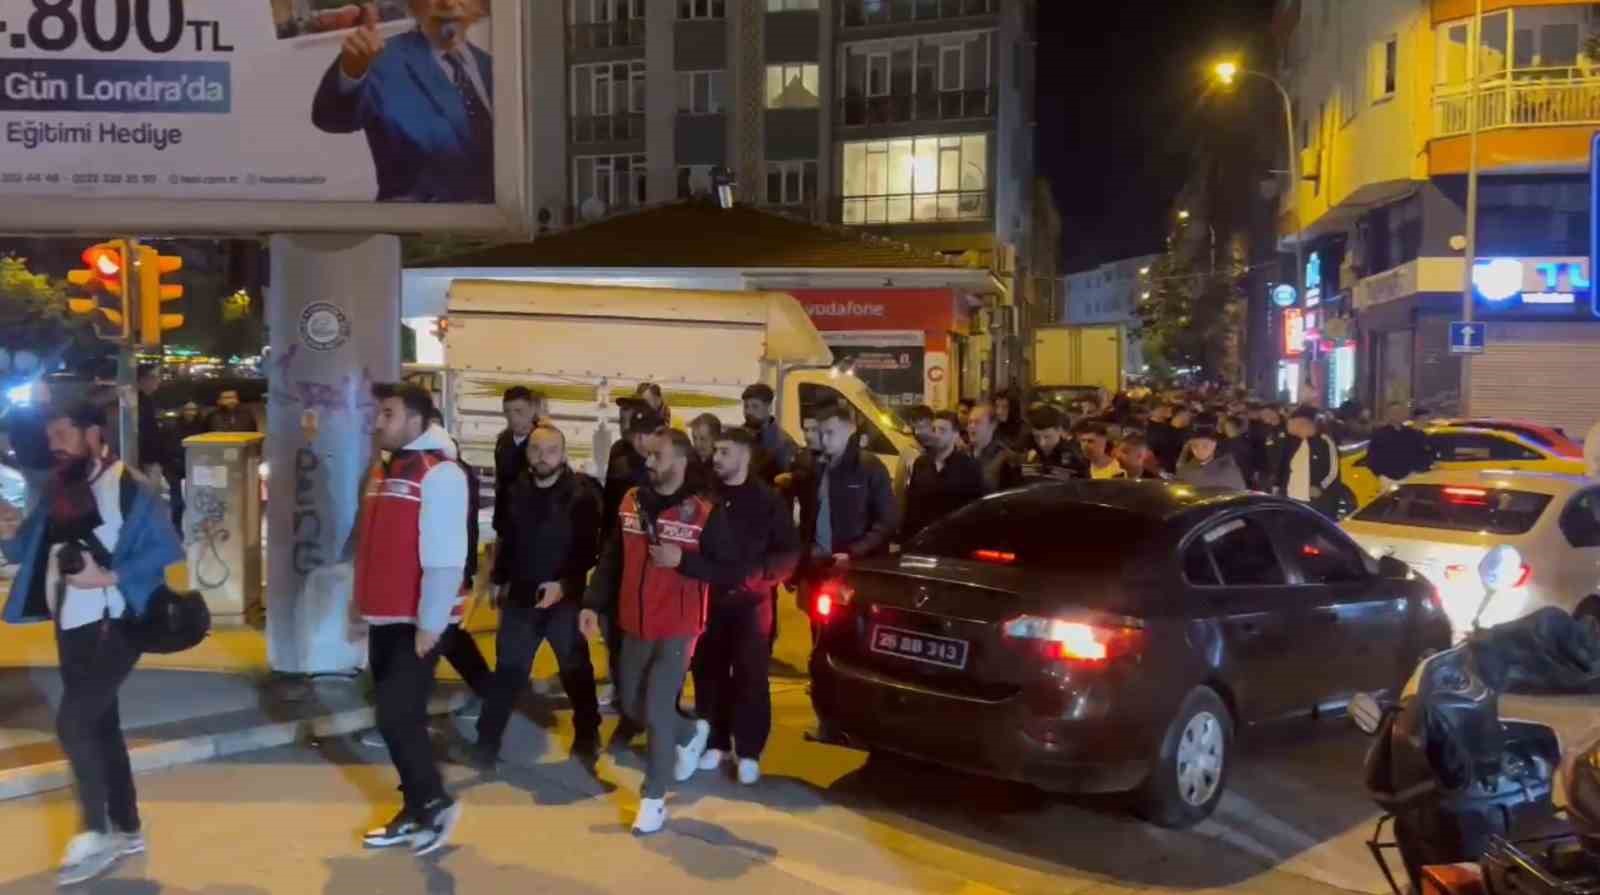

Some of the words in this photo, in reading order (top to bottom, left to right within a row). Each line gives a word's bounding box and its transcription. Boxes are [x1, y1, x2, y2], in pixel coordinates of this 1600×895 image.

[0, 0, 184, 53] .800
[186, 20, 234, 51] TL
[4, 71, 67, 99] Gün
[76, 73, 224, 101] Londra'da
[7, 122, 92, 149] Eğitimi
[100, 122, 182, 151] Hediye
[808, 302, 883, 317] vodafone
